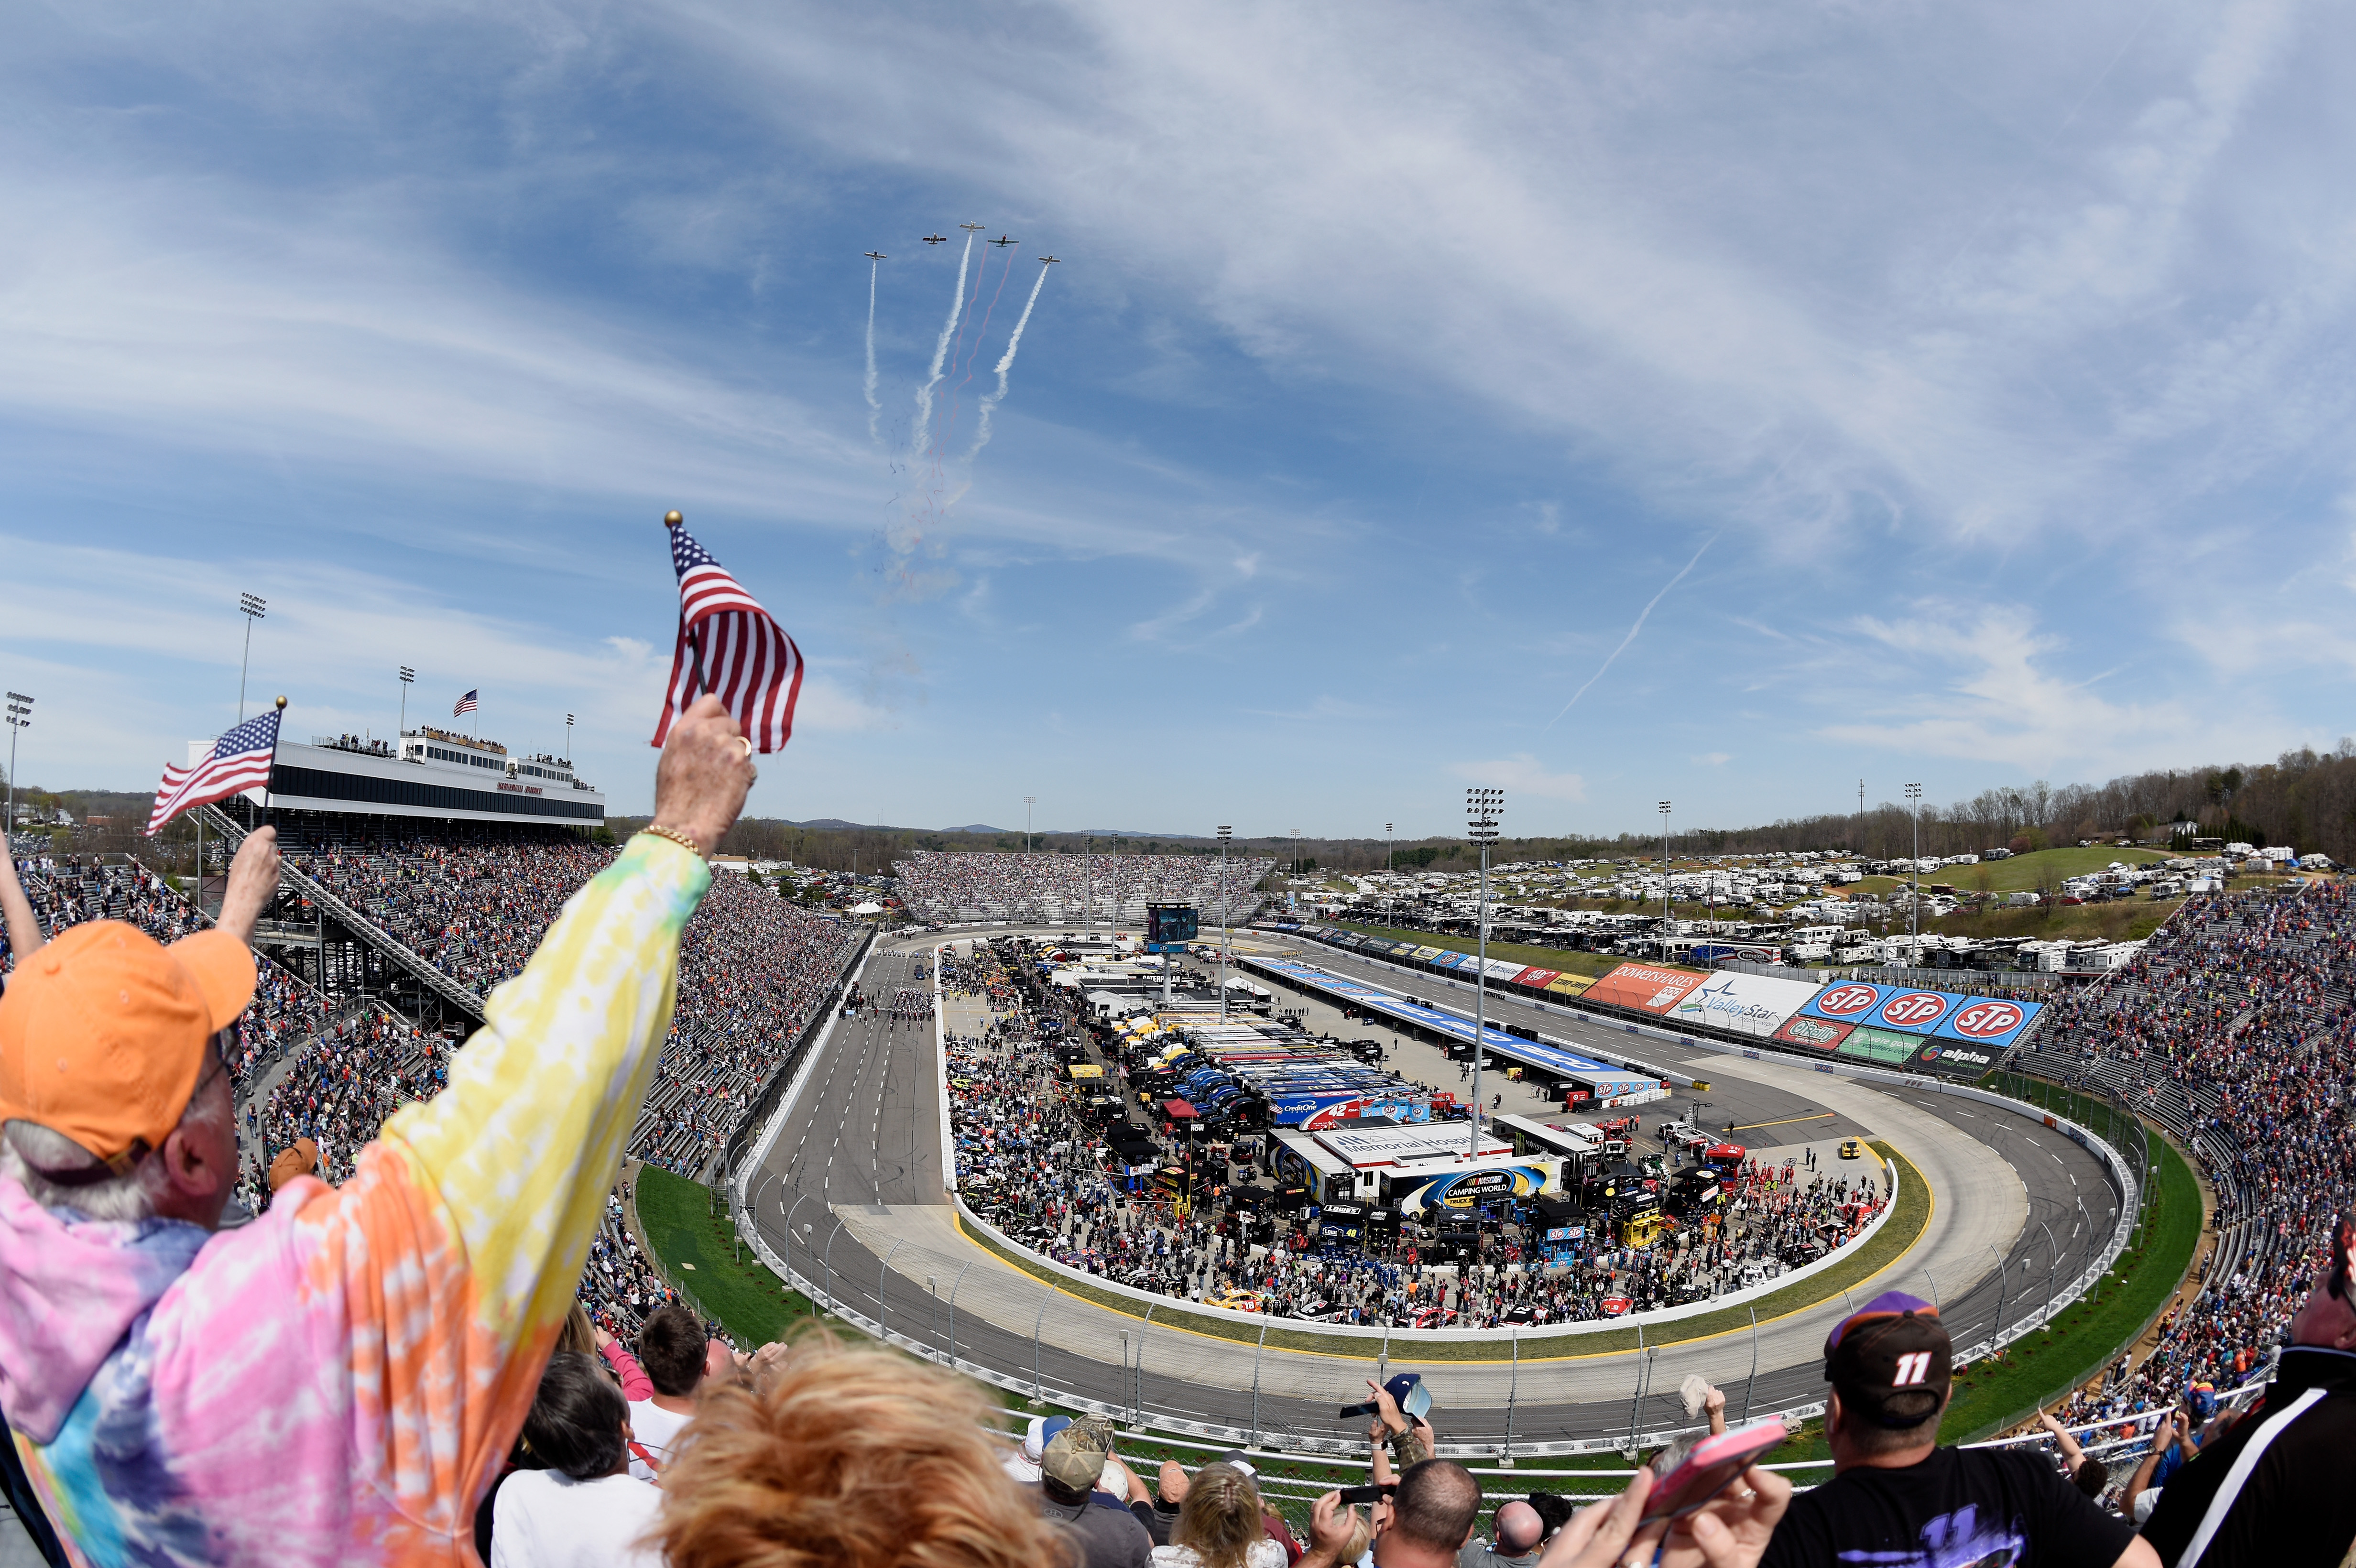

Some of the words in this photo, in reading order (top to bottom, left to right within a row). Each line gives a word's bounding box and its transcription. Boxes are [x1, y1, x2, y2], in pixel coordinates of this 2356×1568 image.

[1442, 955, 1458, 963] STP
[1737, 950, 1765, 961] Champion
[1528, 970, 1545, 980] AAA
[1610, 966, 1697, 988] powerSHARES
[1553, 978, 1586, 989] can-am
[1483, 991, 1505, 1000] ARTINSVILLE
[1661, 987, 1682, 997] QQQ
[1822, 988, 1871, 1010] STP
[1383, 1002, 1444, 1019] GEICO
[1887, 996, 1939, 1021] STP
[1737, 1016, 1756, 1025] CREDIT
[1756, 1019, 1775, 1028] UNION
[1959, 1005, 2015, 1032] STP
[1791, 1020, 1840, 1043] O'Reilly
[1869, 1036, 1890, 1045] we're
[1891, 1039, 1917, 1050] game
[1510, 1045, 1600, 1069] GEICO
[1941, 1049, 1990, 1064] alpha
[1935, 1058, 1957, 1067] Energy
[1957, 1061, 1984, 1071] Solutions
[1598, 1084, 1613, 1094] STP
[1329, 1105, 1347, 1117] 42
[1344, 1141, 1421, 1153] Memorial
[1526, 1140, 1549, 1152] MONSTER
[1783, 1158, 1798, 1166] 42
[1478, 1176, 1503, 1185] NASCAR
[1764, 1181, 1778, 1190] 24
[1448, 1187, 1481, 1197] CAMPING
[1482, 1184, 1506, 1193] WORLD
[1716, 1193, 1726, 1205] 24
[1711, 1213, 1721, 1223] 22
[1346, 1229, 1357, 1237] 48
[1551, 1230, 1563, 1238] STP
[1569, 1228, 1581, 1236] STP
[1244, 1301, 1255, 1309] 18
[1892, 1351, 1932, 1387] 11
[1919, 1503, 1977, 1550] 11
